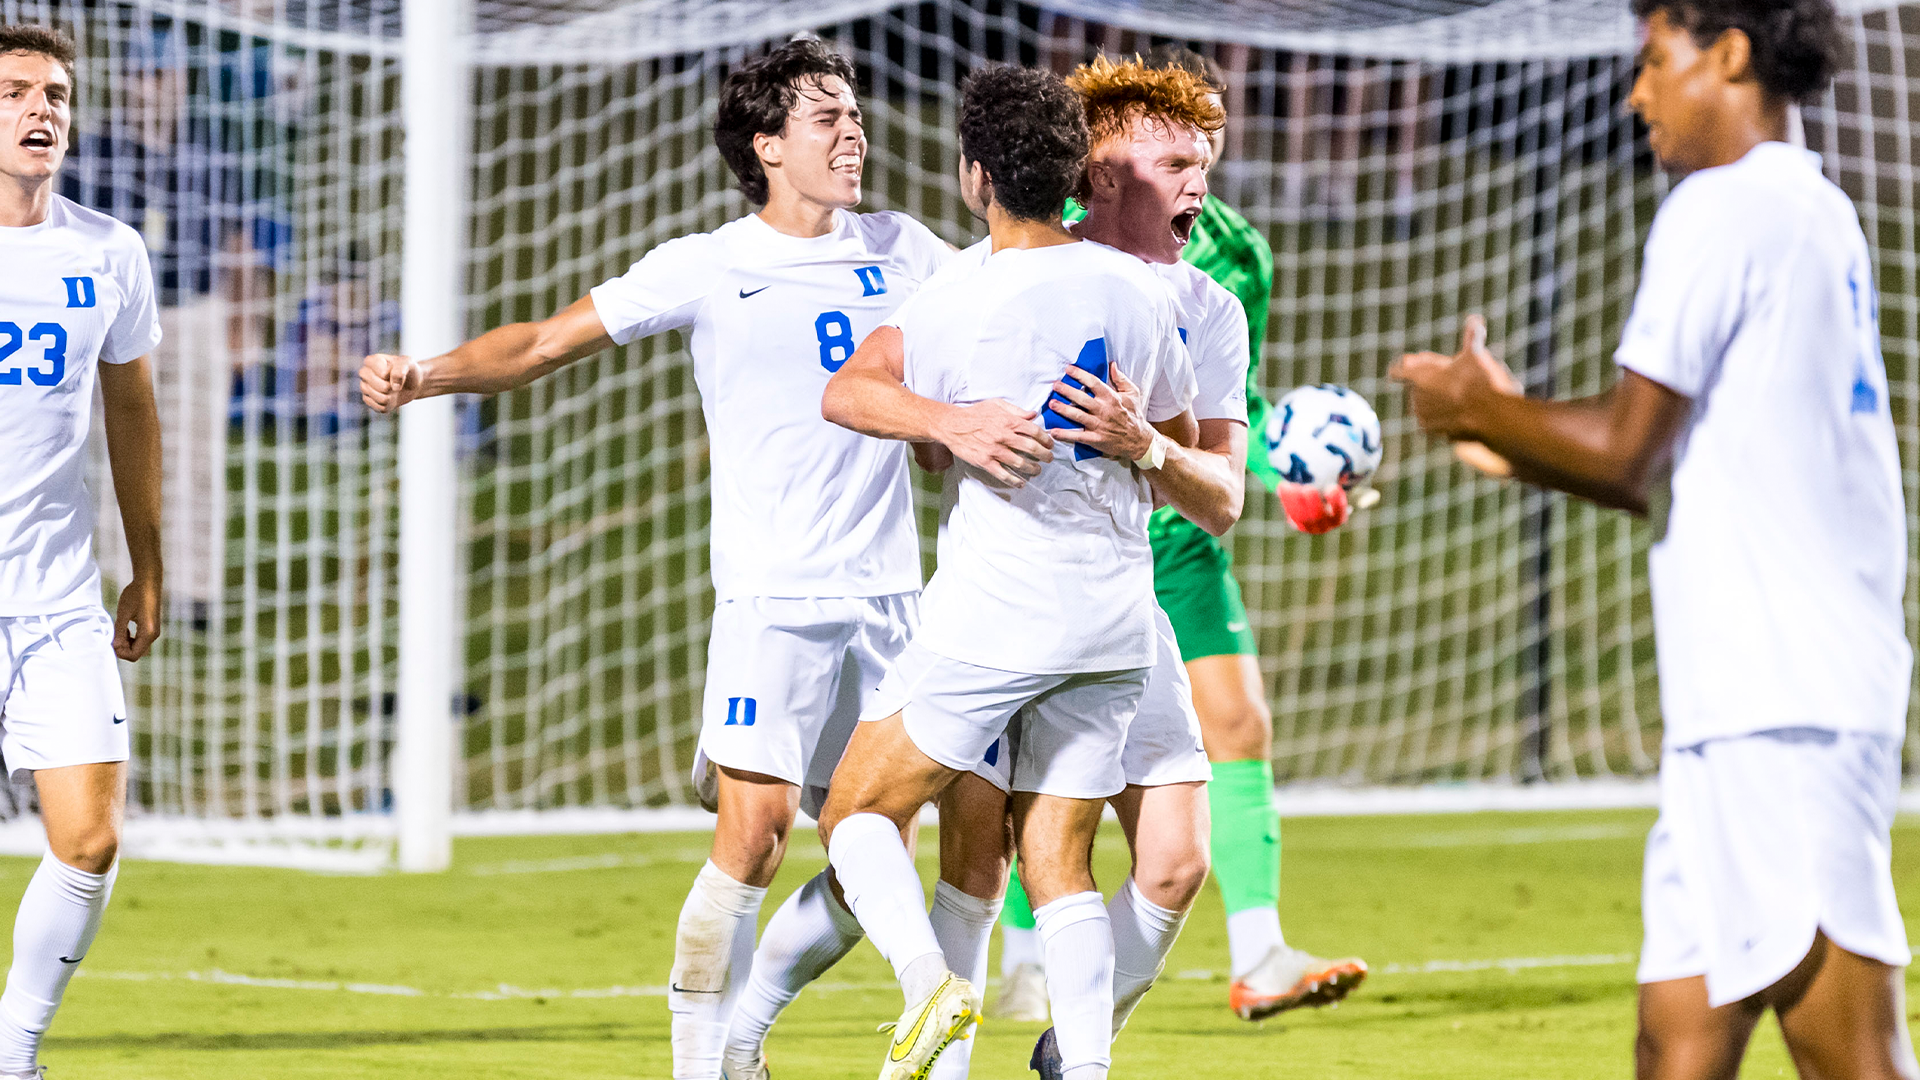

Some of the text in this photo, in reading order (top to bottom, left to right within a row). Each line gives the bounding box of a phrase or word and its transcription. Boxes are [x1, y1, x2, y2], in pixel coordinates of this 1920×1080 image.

[61, 276, 96, 308] D
[853, 265, 888, 297] D
[0, 321, 68, 386] 23
[814, 310, 855, 373] 8
[724, 696, 757, 726] D
